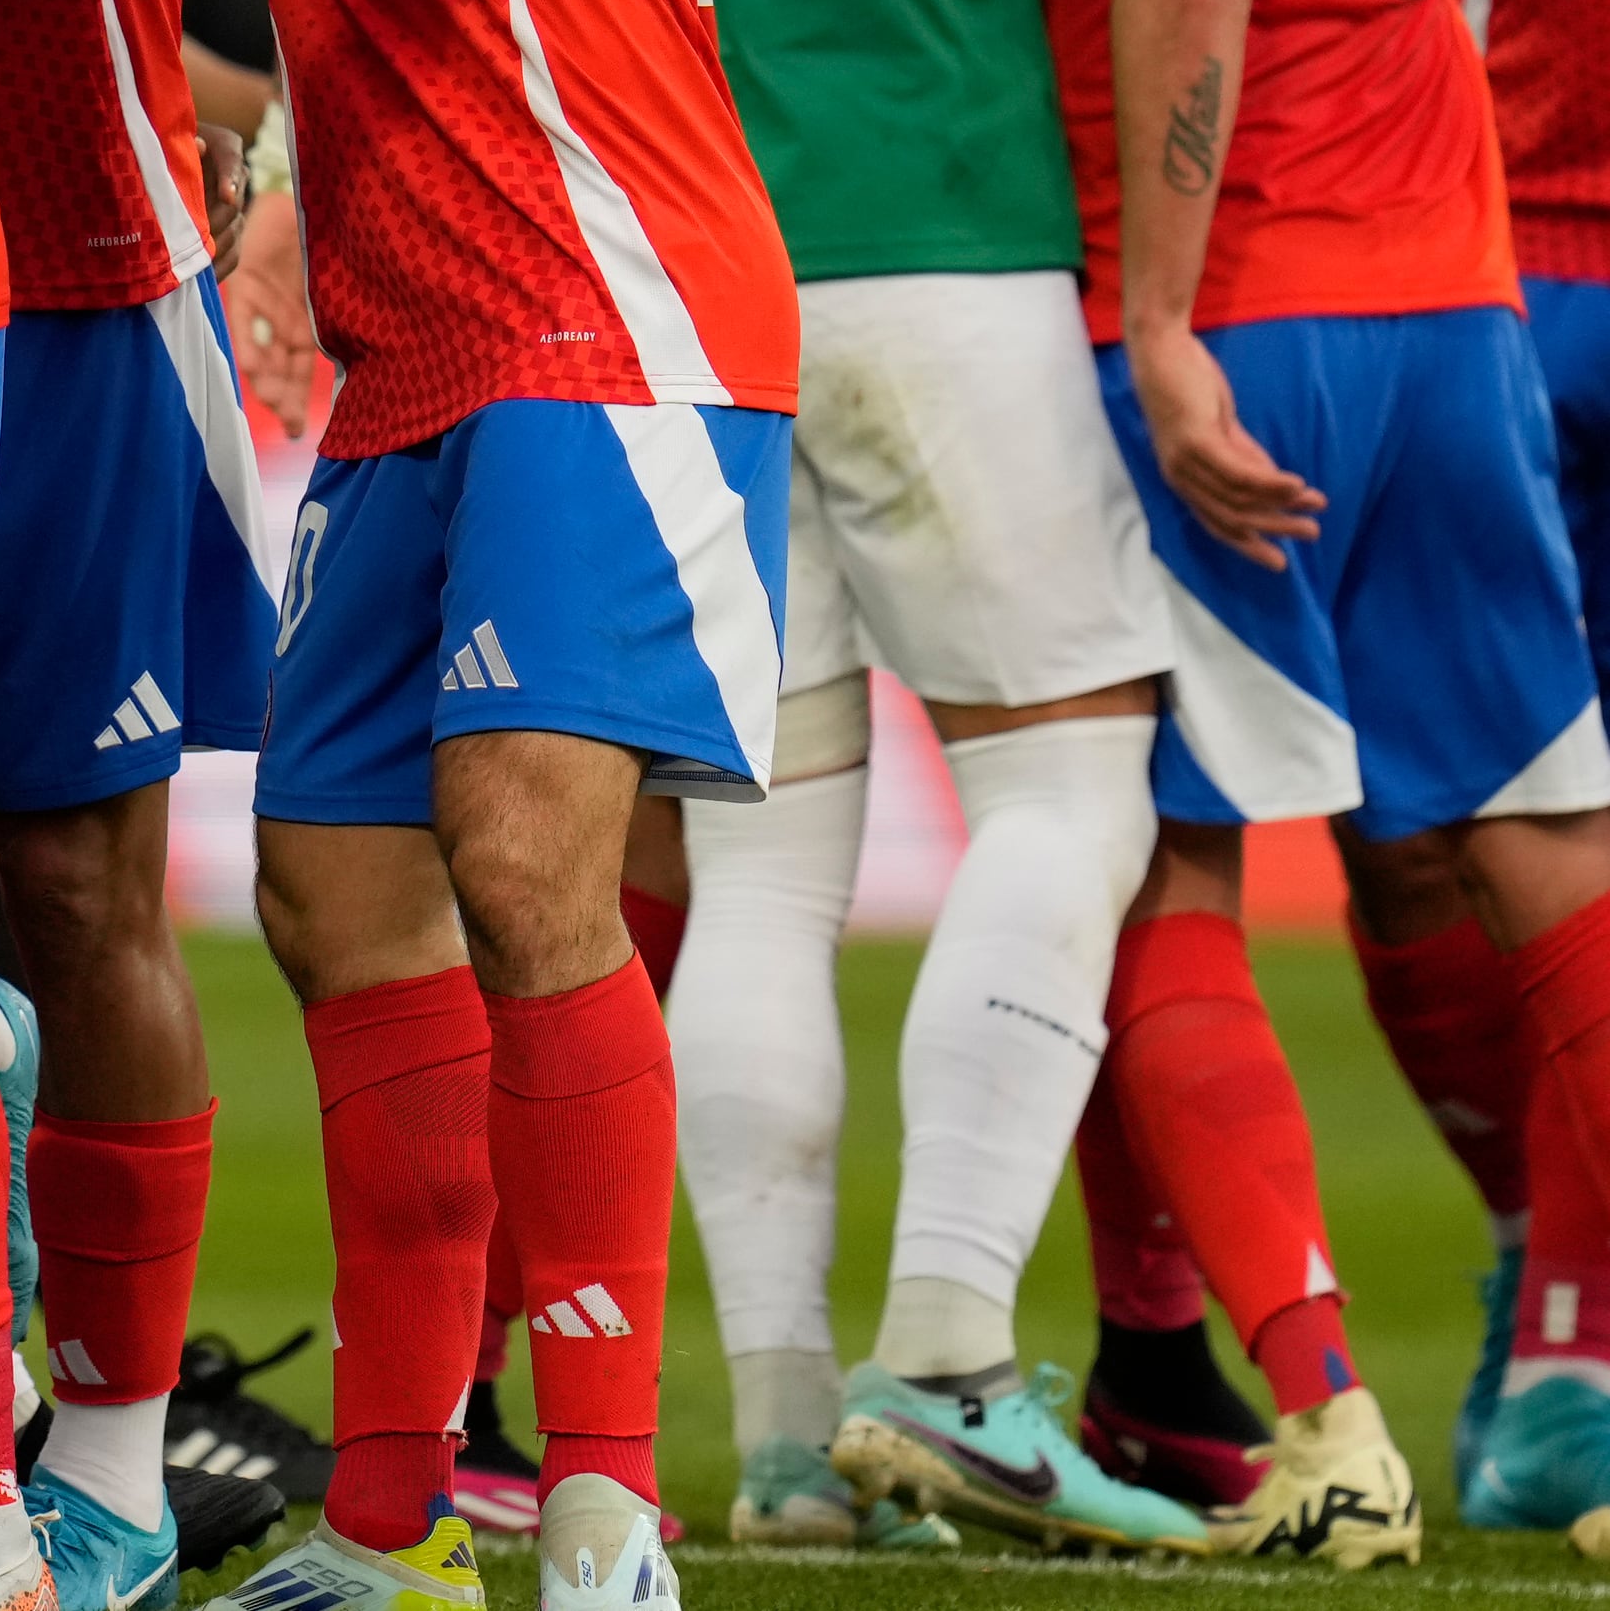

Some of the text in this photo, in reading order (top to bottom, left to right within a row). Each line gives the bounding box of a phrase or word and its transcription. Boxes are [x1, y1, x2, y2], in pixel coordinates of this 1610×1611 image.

[87, 231, 142, 248] AEROREADY
[539, 330, 596, 344] AEROREADY
[581, 1560, 593, 1590] F50
